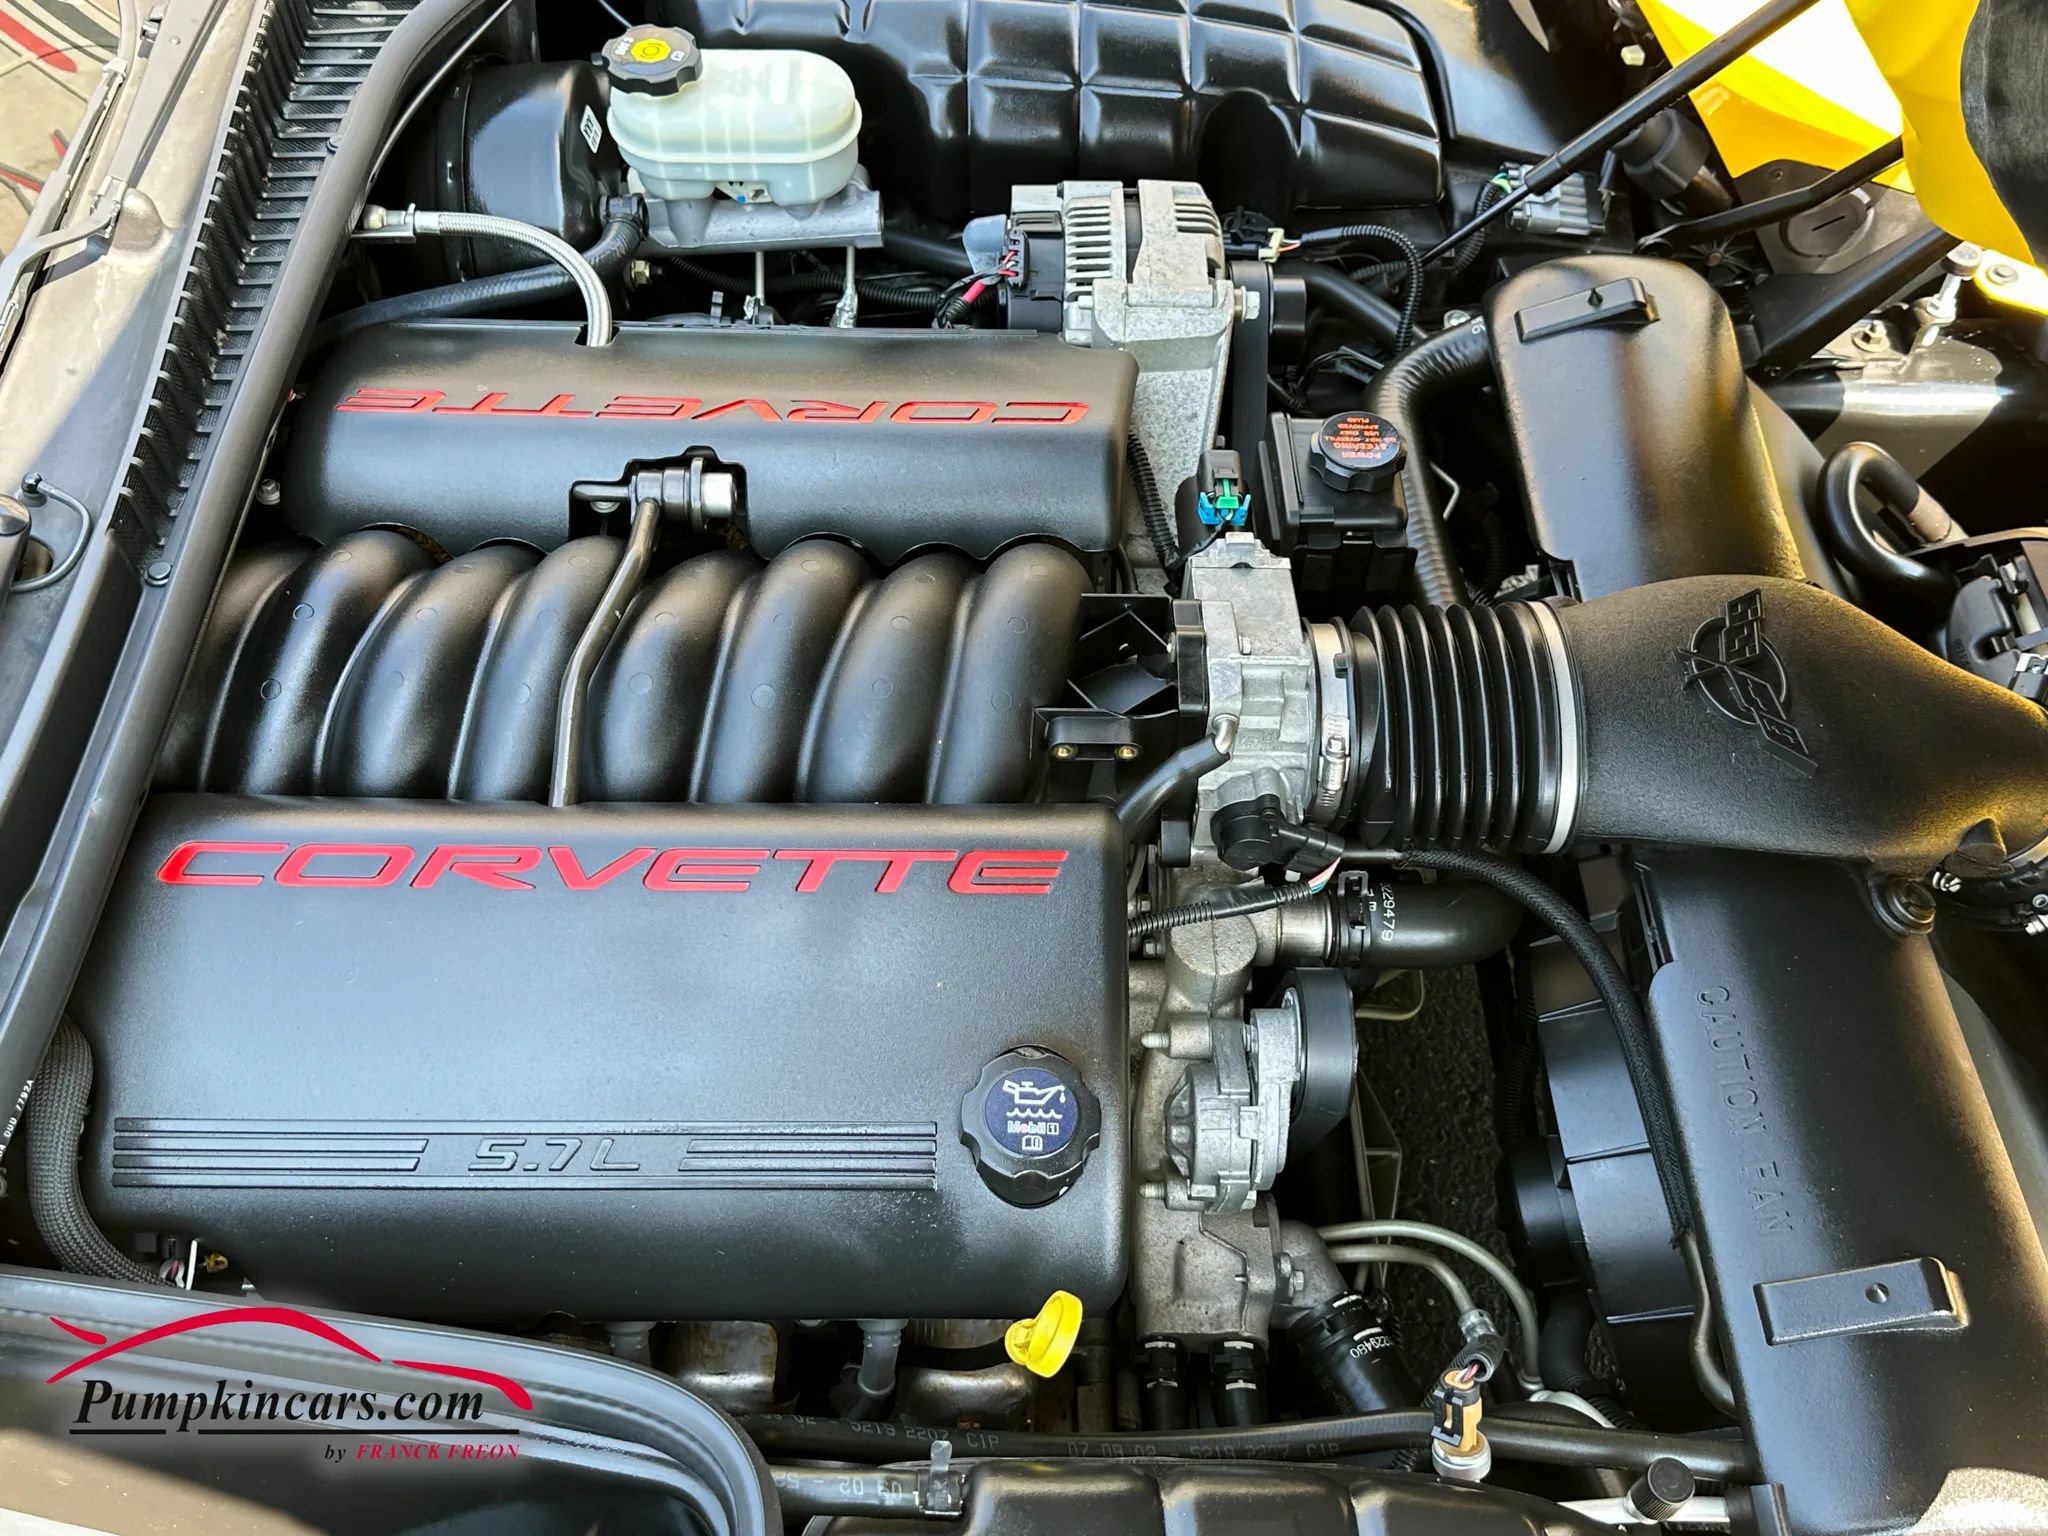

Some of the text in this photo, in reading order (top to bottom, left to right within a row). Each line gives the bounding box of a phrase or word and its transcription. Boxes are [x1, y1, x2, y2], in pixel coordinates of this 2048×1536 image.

[336, 388, 1089, 424] CORVETTE
[156, 841, 1070, 895] CORVETTE
[1697, 985, 1767, 1137] CAUTION
[1007, 1121, 1046, 1135] Mobil
[467, 1137, 641, 1172] 5.7L
